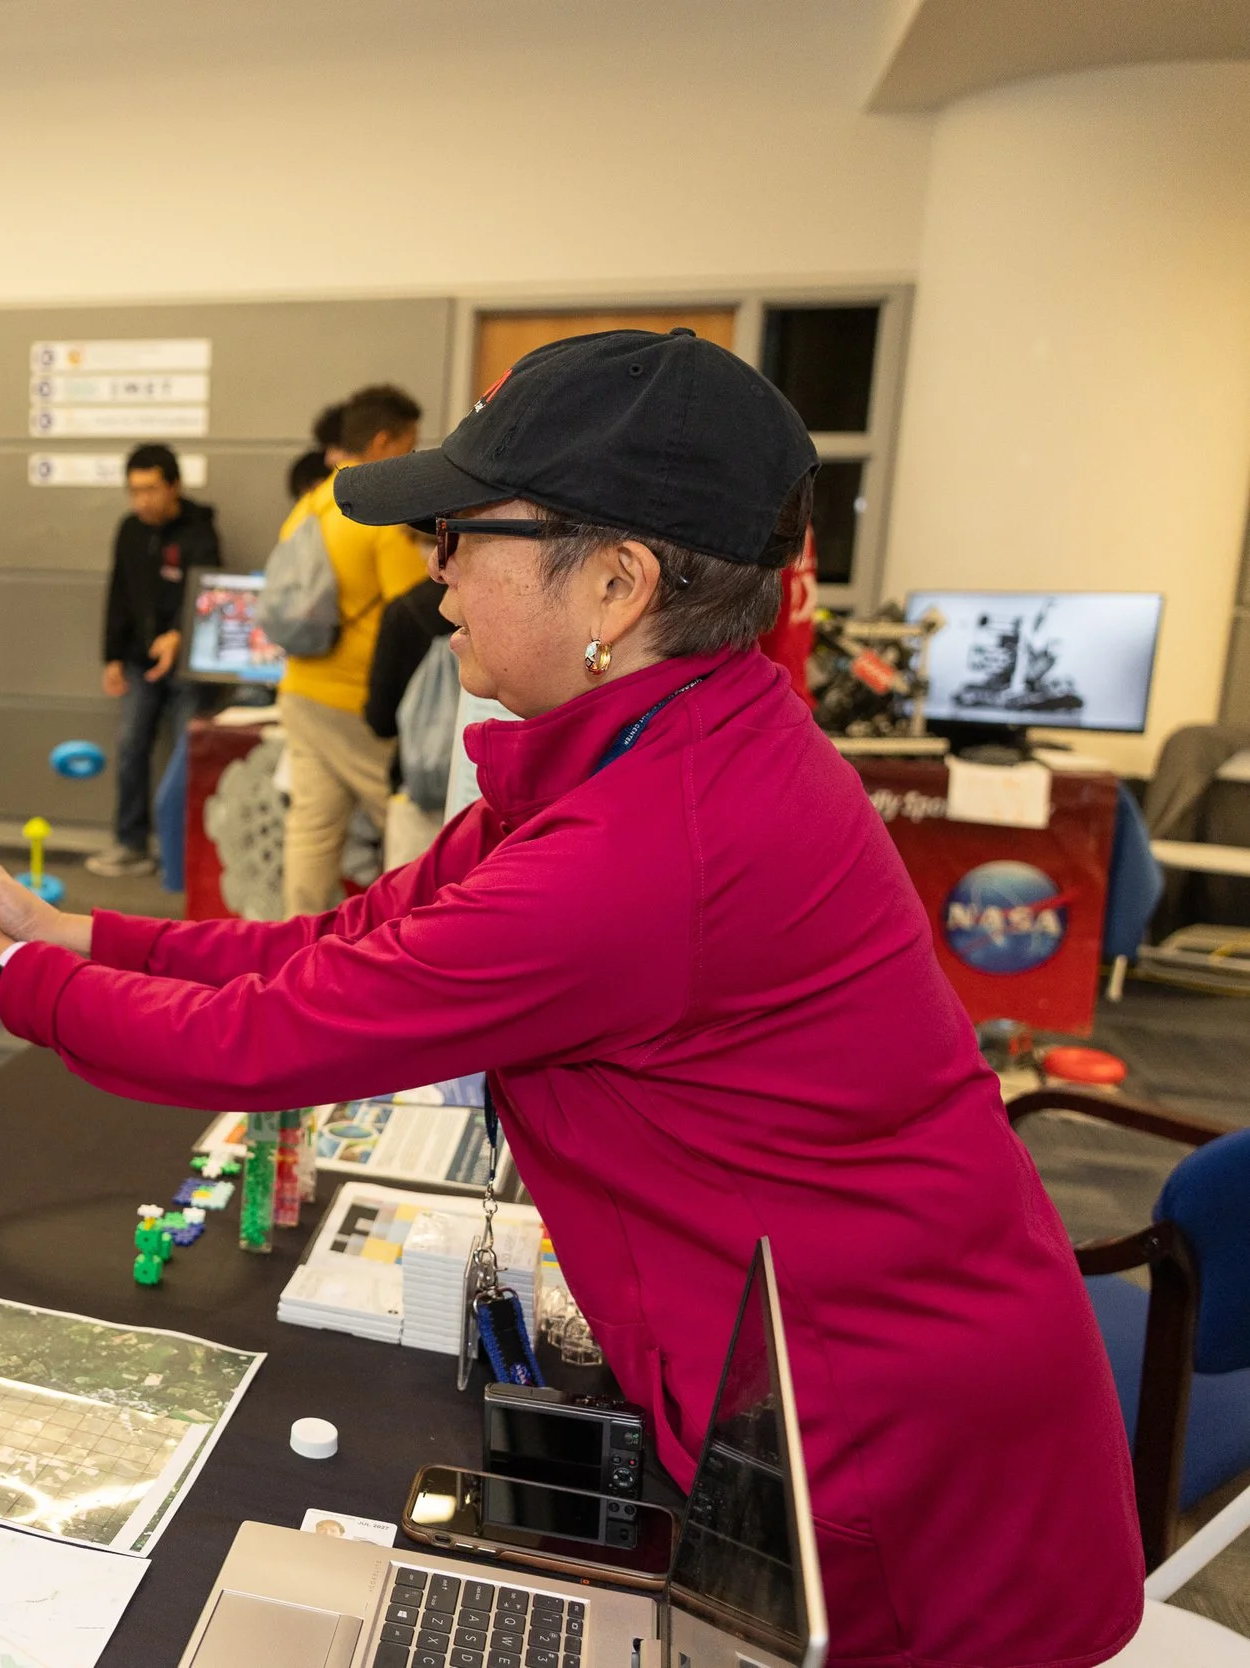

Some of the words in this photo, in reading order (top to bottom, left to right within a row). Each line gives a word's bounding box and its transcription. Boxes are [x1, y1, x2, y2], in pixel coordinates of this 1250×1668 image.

[947, 902, 1062, 940] NASA
[431, 1617, 444, 1625] Z
[469, 1614, 480, 1622] A
[504, 1617, 516, 1625] Q
[427, 1636, 439, 1644] X
[465, 1634, 477, 1642] S
[501, 1636, 513, 1646] W
[422, 1656, 435, 1665] C
[461, 1654, 473, 1662] D
[498, 1657, 510, 1665] E
